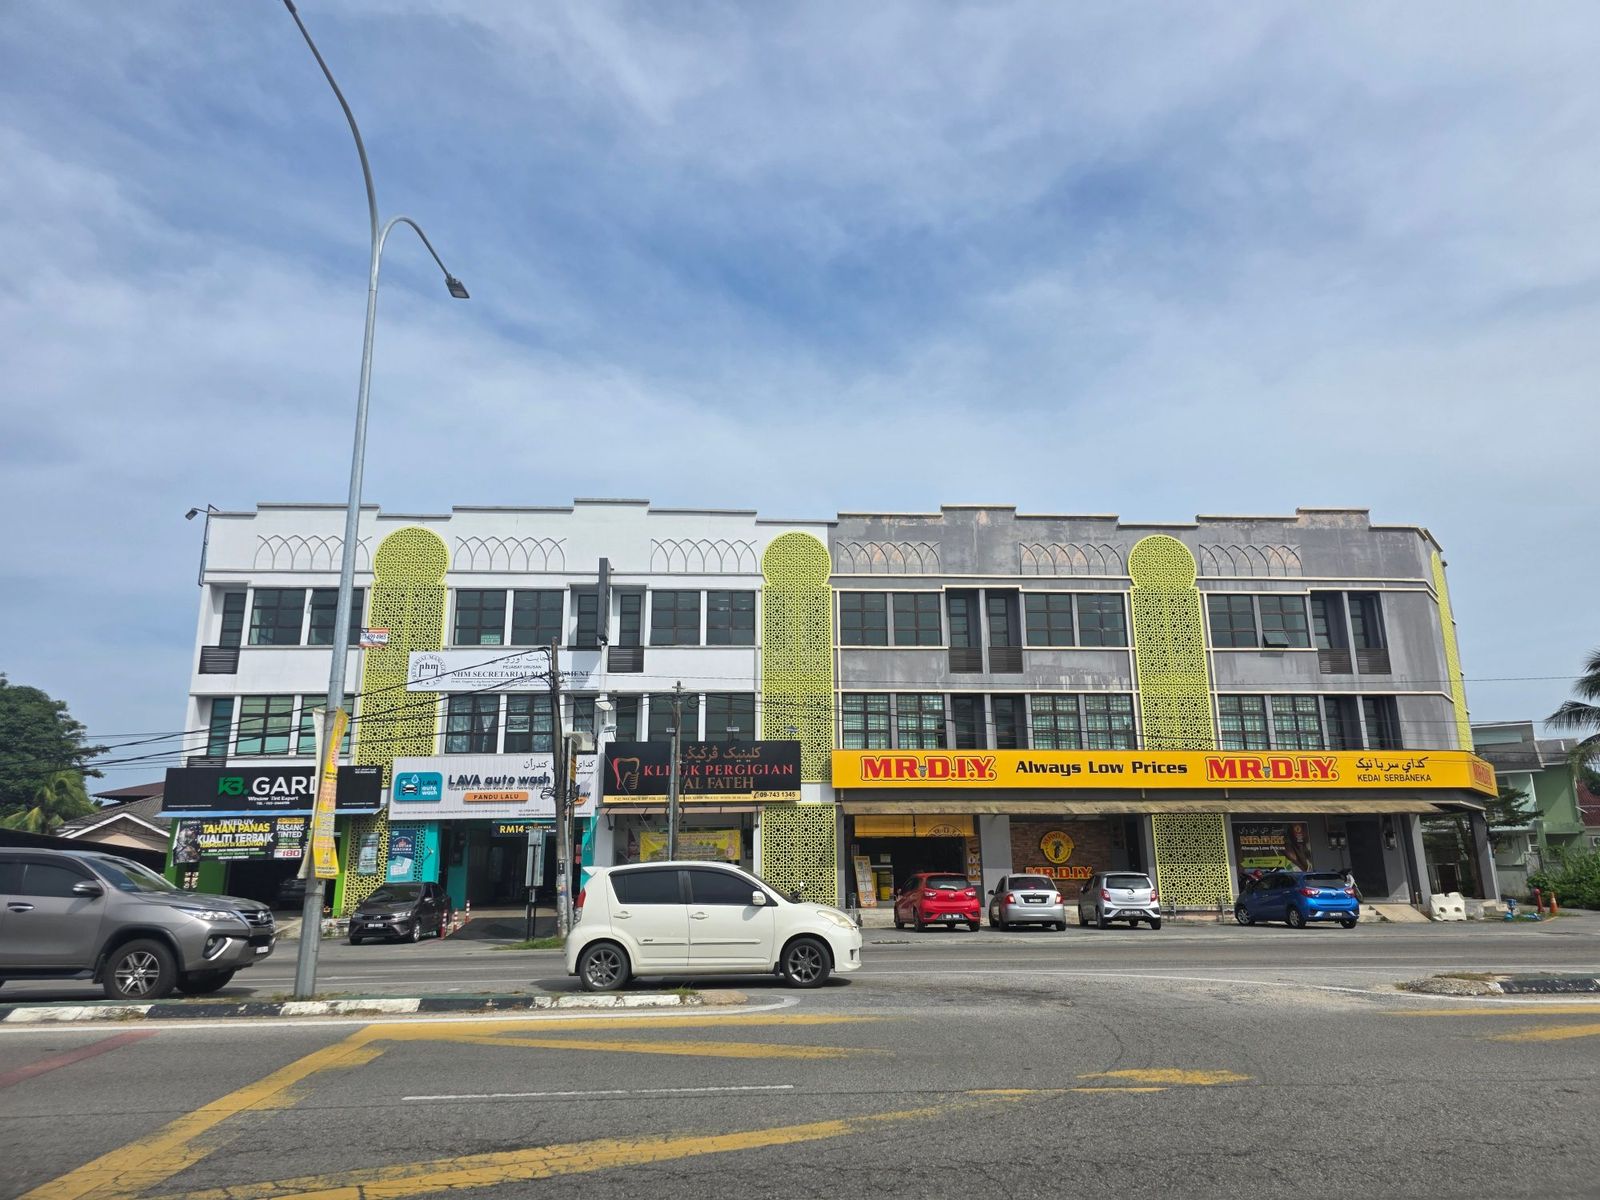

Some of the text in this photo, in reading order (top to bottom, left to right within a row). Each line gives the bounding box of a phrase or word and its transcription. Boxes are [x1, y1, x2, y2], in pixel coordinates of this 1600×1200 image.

[705, 764, 793, 776] PERGIGIAN
[1016, 760, 1188, 776] Always Low Prices
[448, 771, 551, 787] LAVA auto wash
[685, 776, 754, 789] AL FATEH
[1357, 773, 1432, 782] KEDAI SERBANEKA
[203, 822, 271, 834] TAHAN PANAS
[500, 825, 525, 833] RM14
[197, 834, 234, 844] KUALITI
[234, 833, 275, 843] TERBAIK
